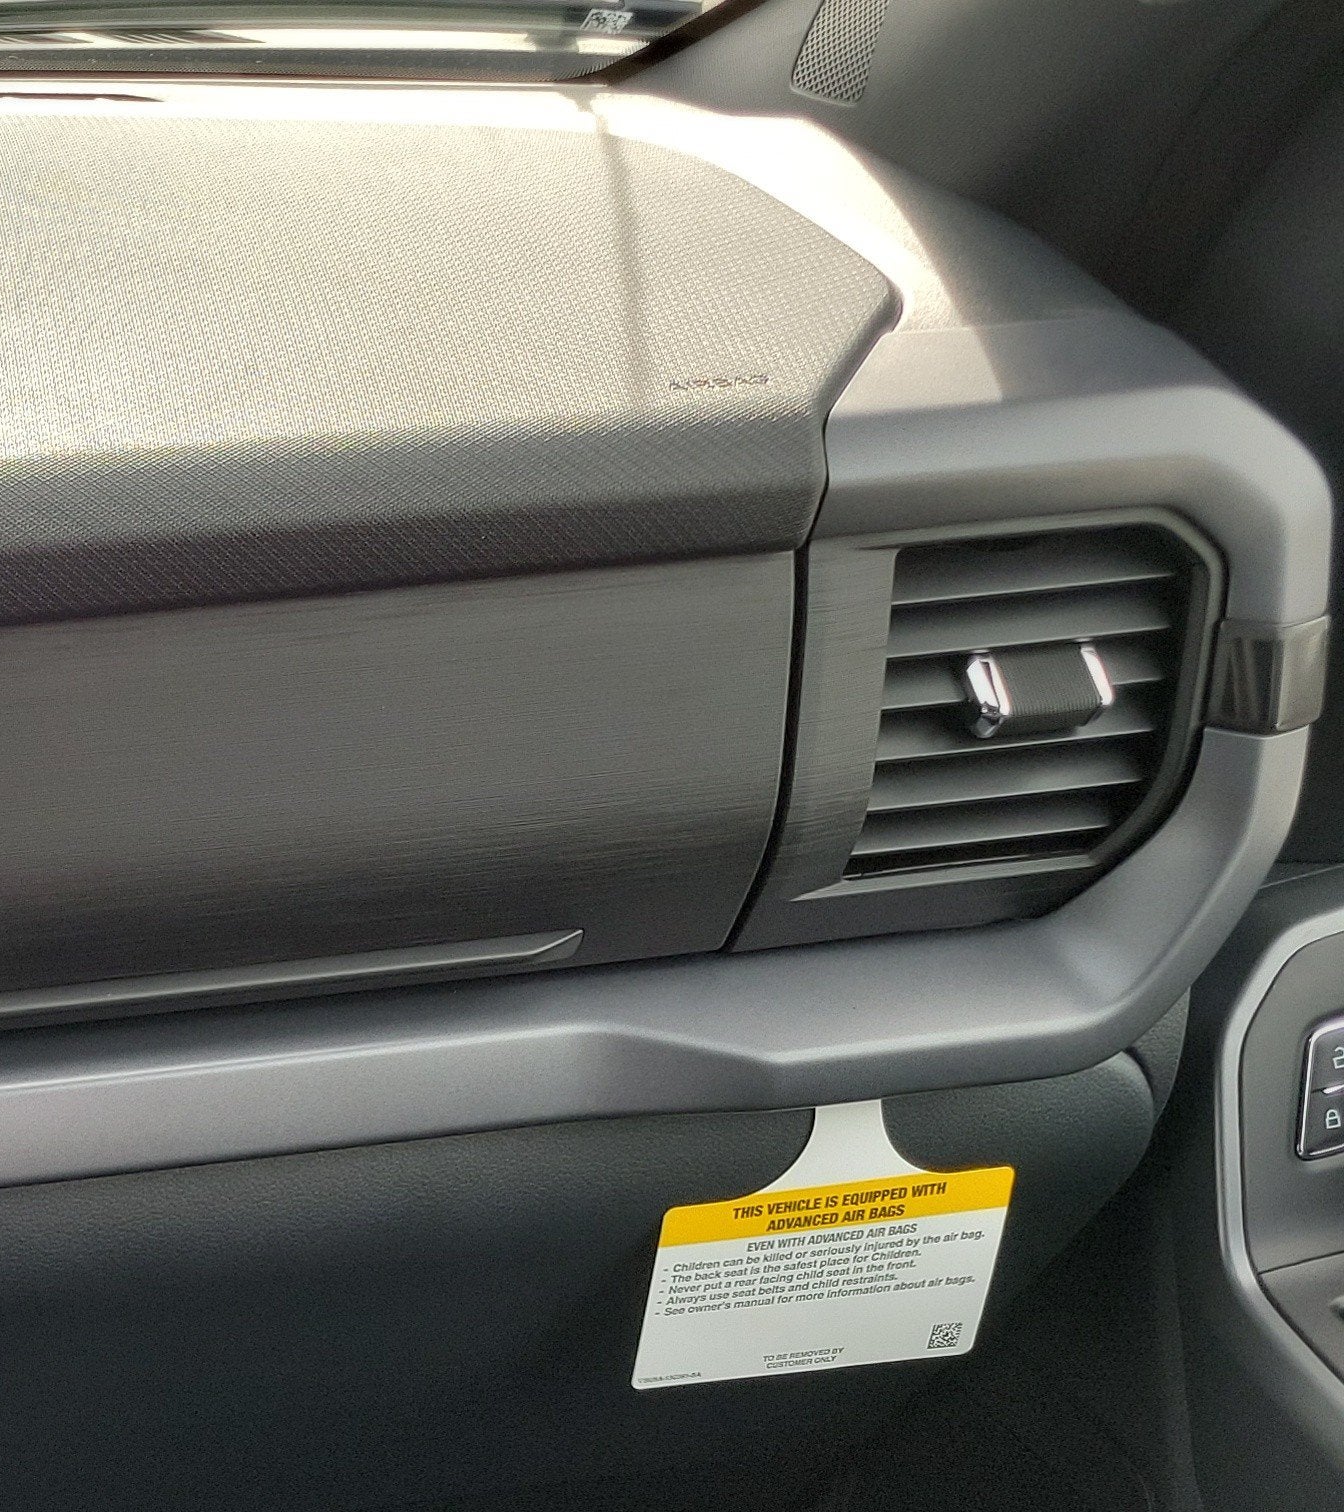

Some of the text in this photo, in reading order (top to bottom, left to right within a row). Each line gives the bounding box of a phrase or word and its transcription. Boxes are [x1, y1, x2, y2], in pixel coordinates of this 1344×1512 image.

[732, 1182, 947, 1219] THIS VEHICLE IS EQUIPPED WITH
[766, 1204, 905, 1231] ADVANCED AIR BAGS
[673, 1230, 985, 1272] Children can be killed or seriously injured by the air bag.
[747, 1223, 918, 1252] EVEN WITH ADVANCED AIR BAGS
[668, 1284, 701, 1295] Never
[703, 1281, 722, 1292] put
[734, 1277, 757, 1288] rear
[759, 1274, 793, 1287] facing
[796, 1270, 824, 1281] child
[826, 1266, 850, 1277] seat
[853, 1265, 863, 1274] in
[866, 1262, 884, 1273] the
[887, 1259, 917, 1270] front.
[671, 1249, 922, 1284] The back seat is the safest place for Children.
[664, 1274, 975, 1317] See owner's manual for more information about air bags.
[666, 1272, 898, 1306] Always use seat belts and child restraints.
